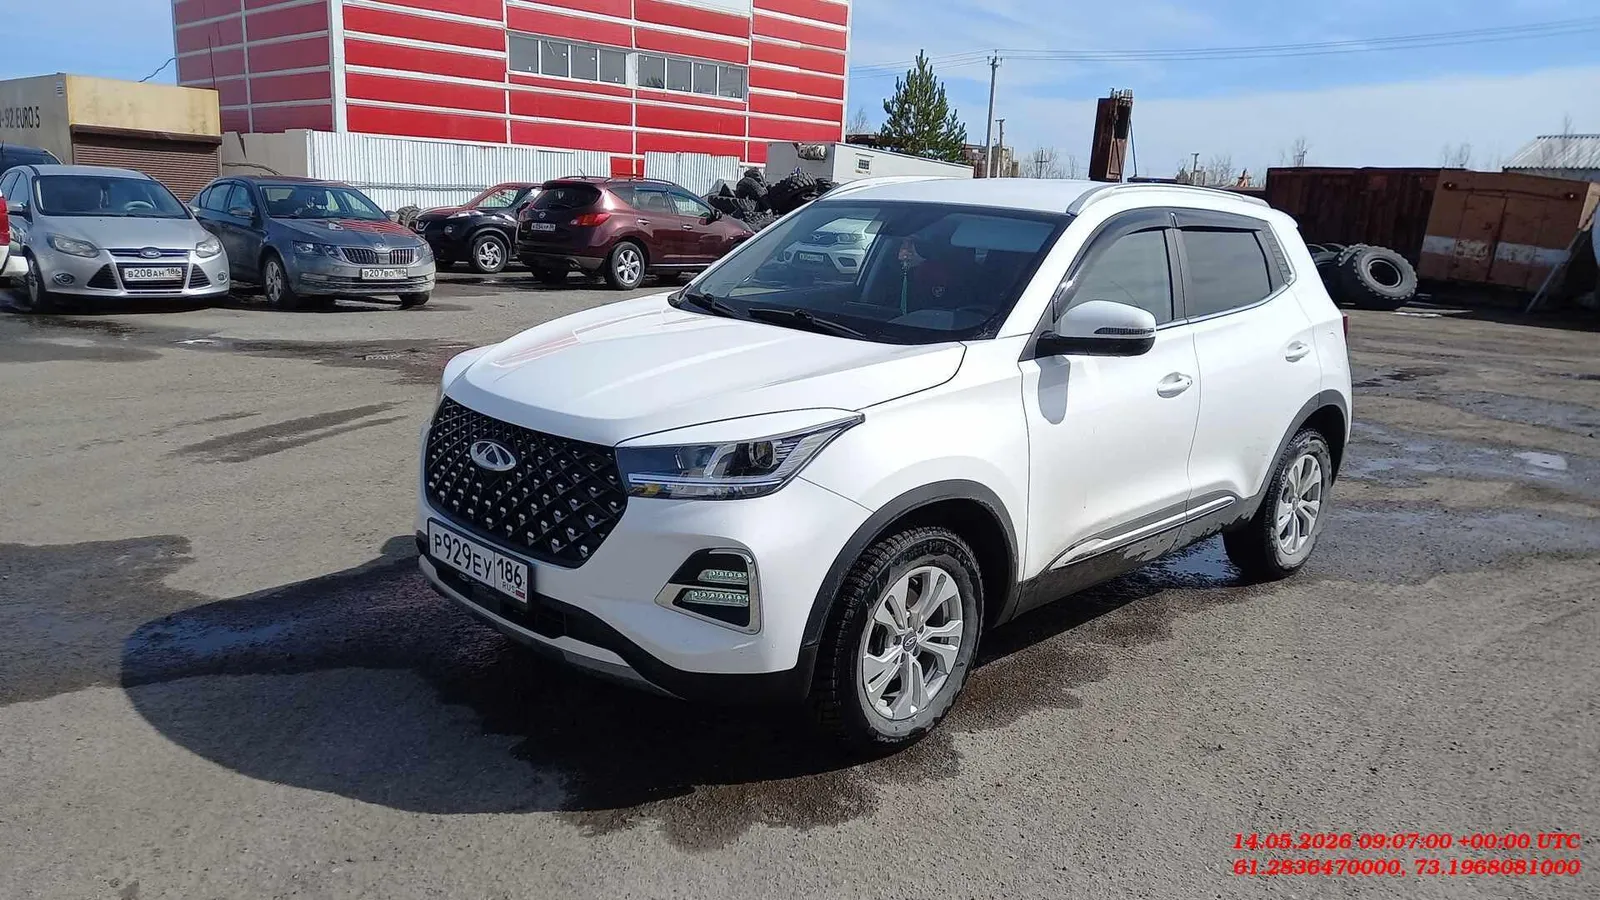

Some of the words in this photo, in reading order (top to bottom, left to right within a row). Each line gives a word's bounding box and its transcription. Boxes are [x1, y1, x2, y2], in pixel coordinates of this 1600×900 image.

[16, 106, 34, 129] EURO
[35, 106, 41, 129] 5
[497, 557, 523, 588] 186
[502, 581, 516, 594] RUS
